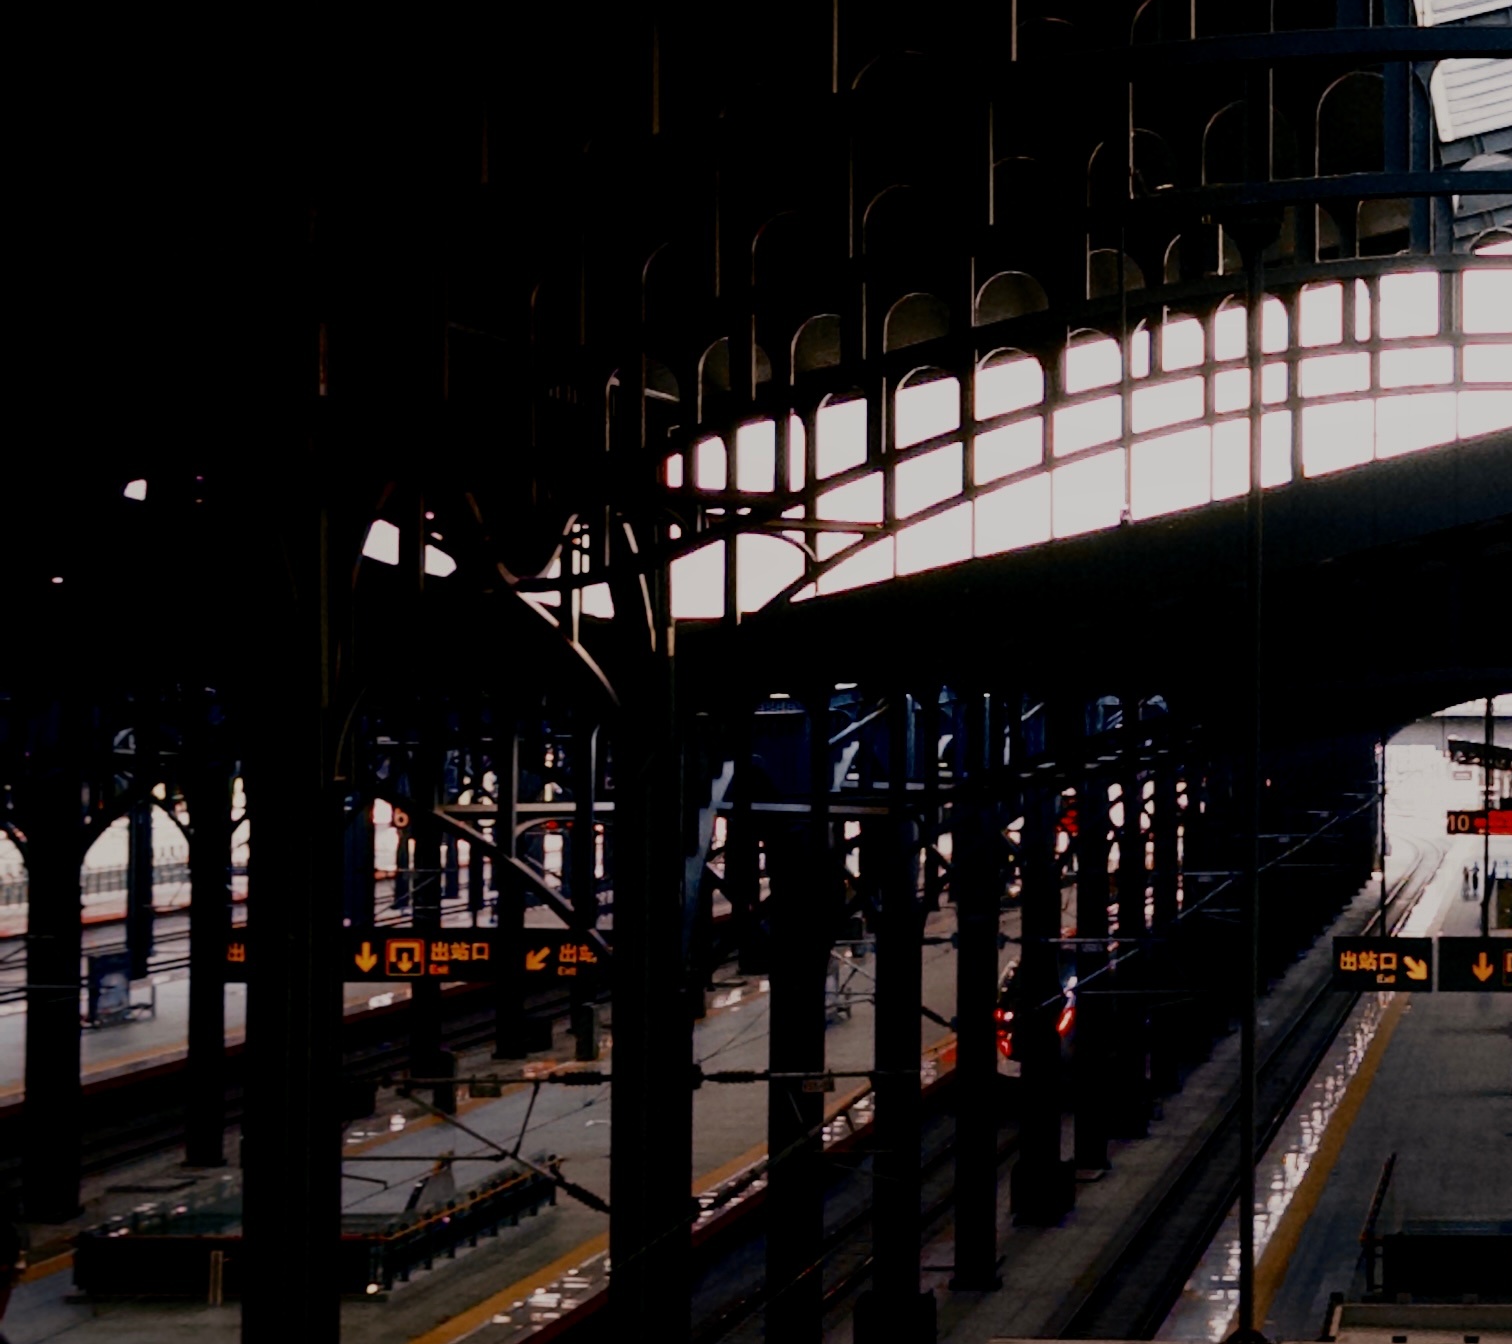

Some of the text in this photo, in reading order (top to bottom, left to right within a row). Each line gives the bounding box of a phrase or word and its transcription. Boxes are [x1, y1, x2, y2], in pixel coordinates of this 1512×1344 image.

[429, 941, 490, 961] 出站口
[1339, 951, 1397, 971] 出站口
[1376, 973, 1396, 984] Exit
